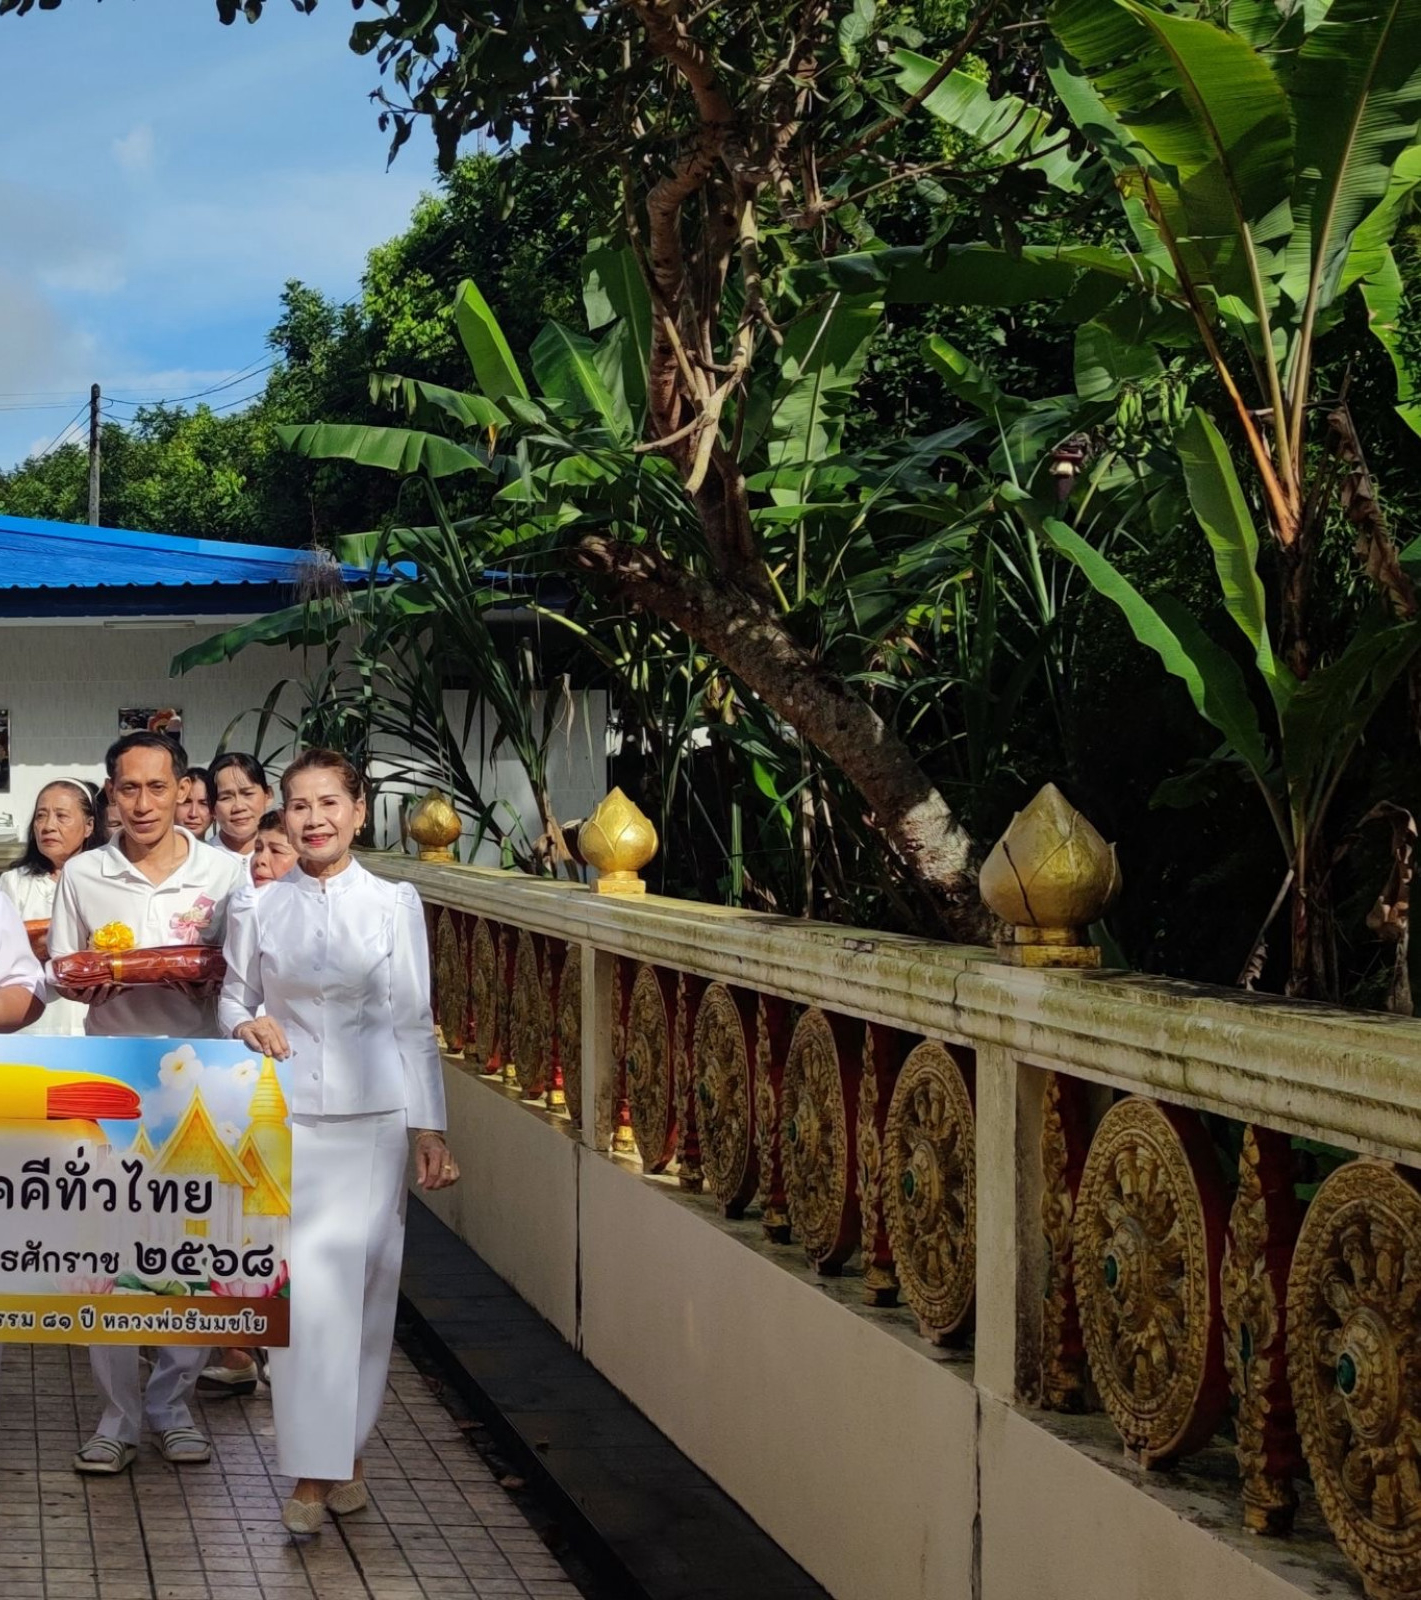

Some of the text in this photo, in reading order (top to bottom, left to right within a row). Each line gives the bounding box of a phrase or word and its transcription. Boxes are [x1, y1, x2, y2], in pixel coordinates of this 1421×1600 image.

[134, 1241, 274, 1277] ๒๕๖๘
[43, 1313, 71, 1329] ๘๑
[81, 1306, 94, 1328] ปี
[103, 1308, 266, 1332] หลวงพ่อธัมมชโย
